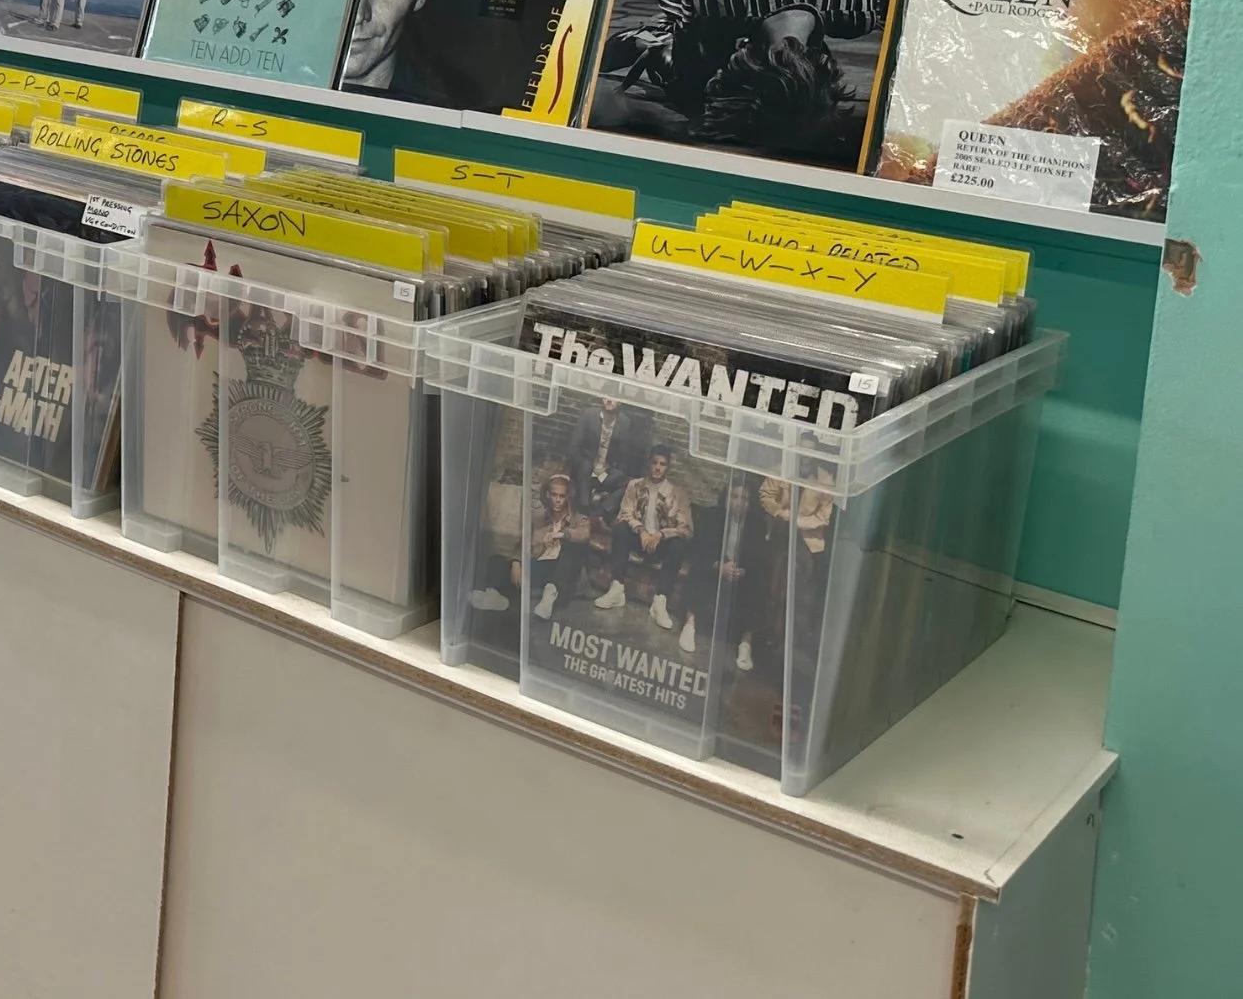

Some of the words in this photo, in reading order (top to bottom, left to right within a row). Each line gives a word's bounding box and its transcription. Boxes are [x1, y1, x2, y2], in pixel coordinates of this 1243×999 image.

[190, 39, 216, 61] TEN
[219, 44, 251, 67] ADD
[257, 49, 286, 73] TEN
[522, 42, 552, 112] FIELDS
[546, 6, 563, 32] OF
[33, 124, 103, 157] ROLLING
[109, 143, 180, 171] STONES
[958, 129, 1007, 147] QUEEN
[954, 153, 973, 164] 2005
[974, 155, 1010, 169] SEALED
[1012, 161, 1019, 170] 3
[1020, 162, 1032, 173] LP
[1033, 164, 1055, 176] BOX
[1056, 168, 1074, 179] SET
[956, 143, 995, 157] RETURN
[995, 149, 1009, 158] OF
[1011, 151, 1031, 163] THE
[1031, 155, 1092, 171] CHAMPIONS
[950, 173, 995, 190] £225.00
[87, 205, 110, 218] MONO
[203, 199, 306, 237] SAXON
[399, 287, 411, 298] 15
[2, 349, 75, 406] AFTER
[532, 322, 616, 387] The
[621, 343, 860, 445] WANTED
[855, 377, 873, 390] 15
[549, 621, 613, 664] MOST
[615, 642, 709, 698] WANTED
[563, 652, 588, 676] THE
[589, 660, 654, 699] GREATEST
[654, 681, 687, 711] HITS
